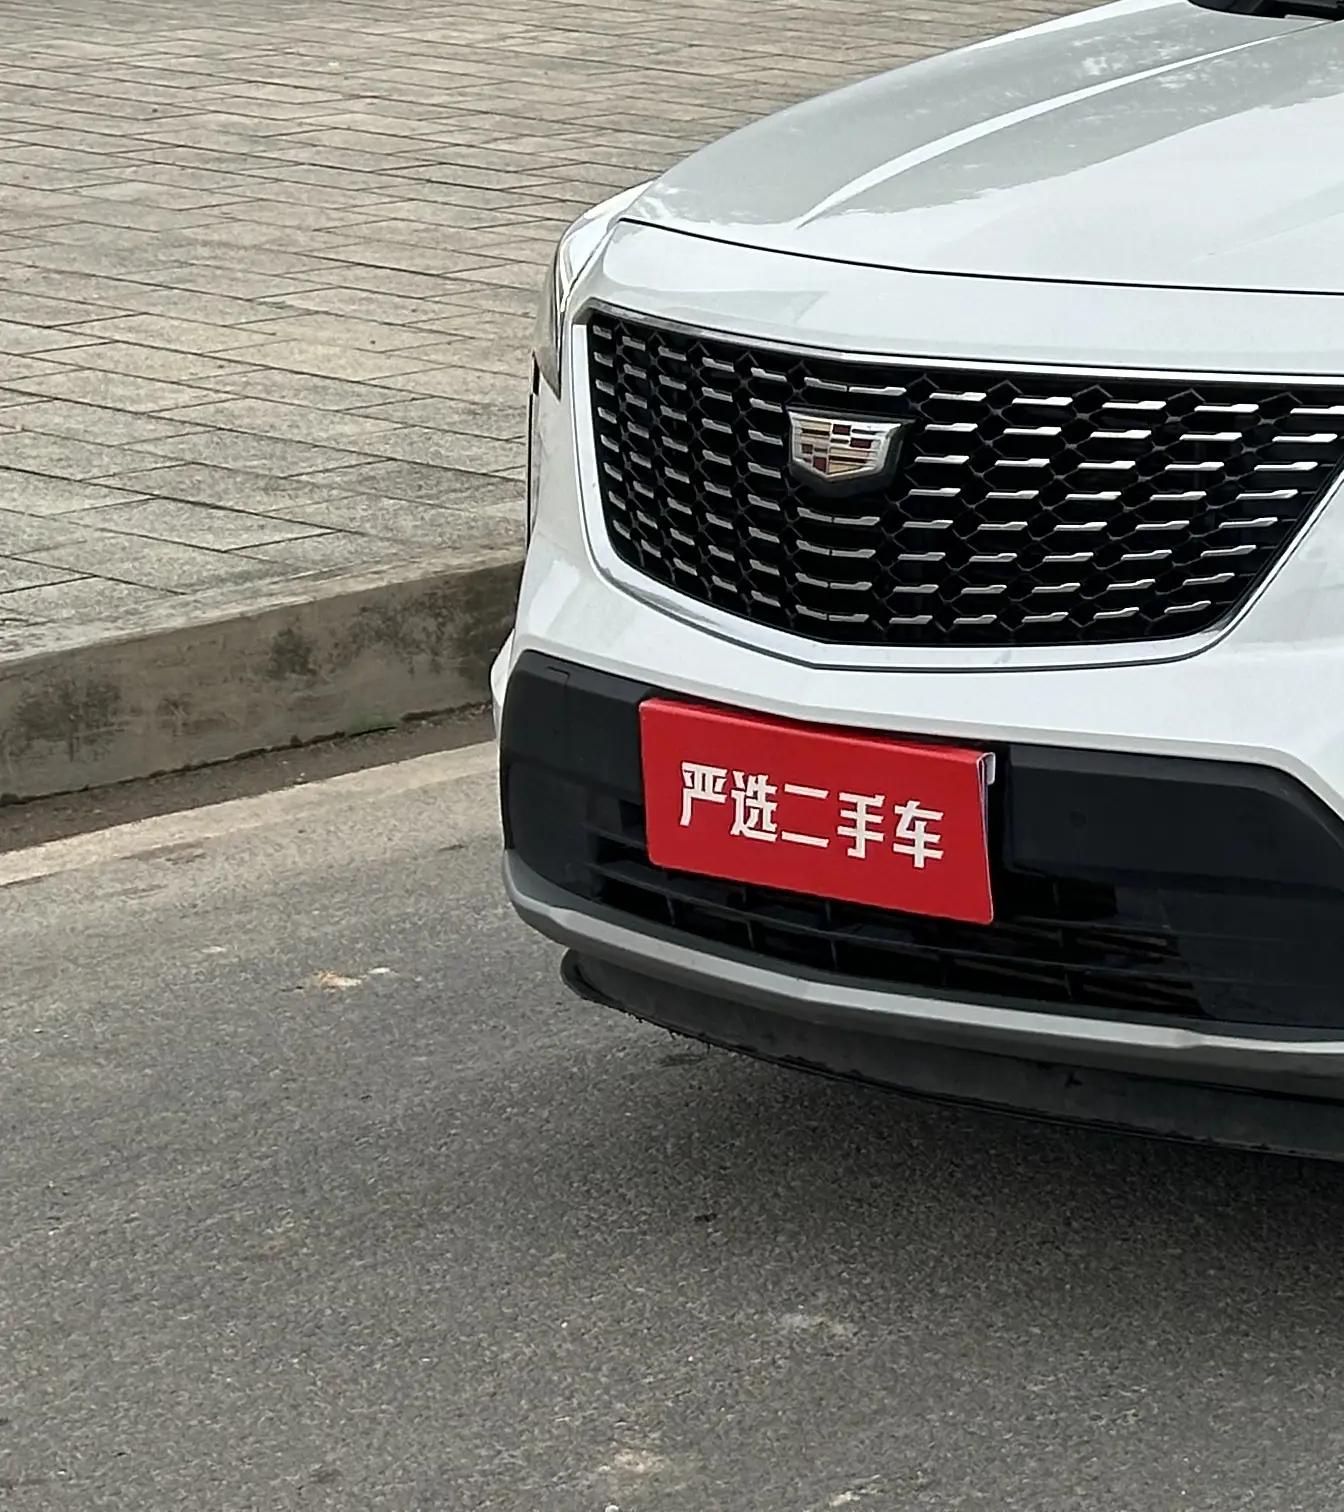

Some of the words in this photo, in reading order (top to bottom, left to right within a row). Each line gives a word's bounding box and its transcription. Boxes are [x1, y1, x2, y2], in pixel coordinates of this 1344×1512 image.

[679, 761, 945, 869] 严选二手车
